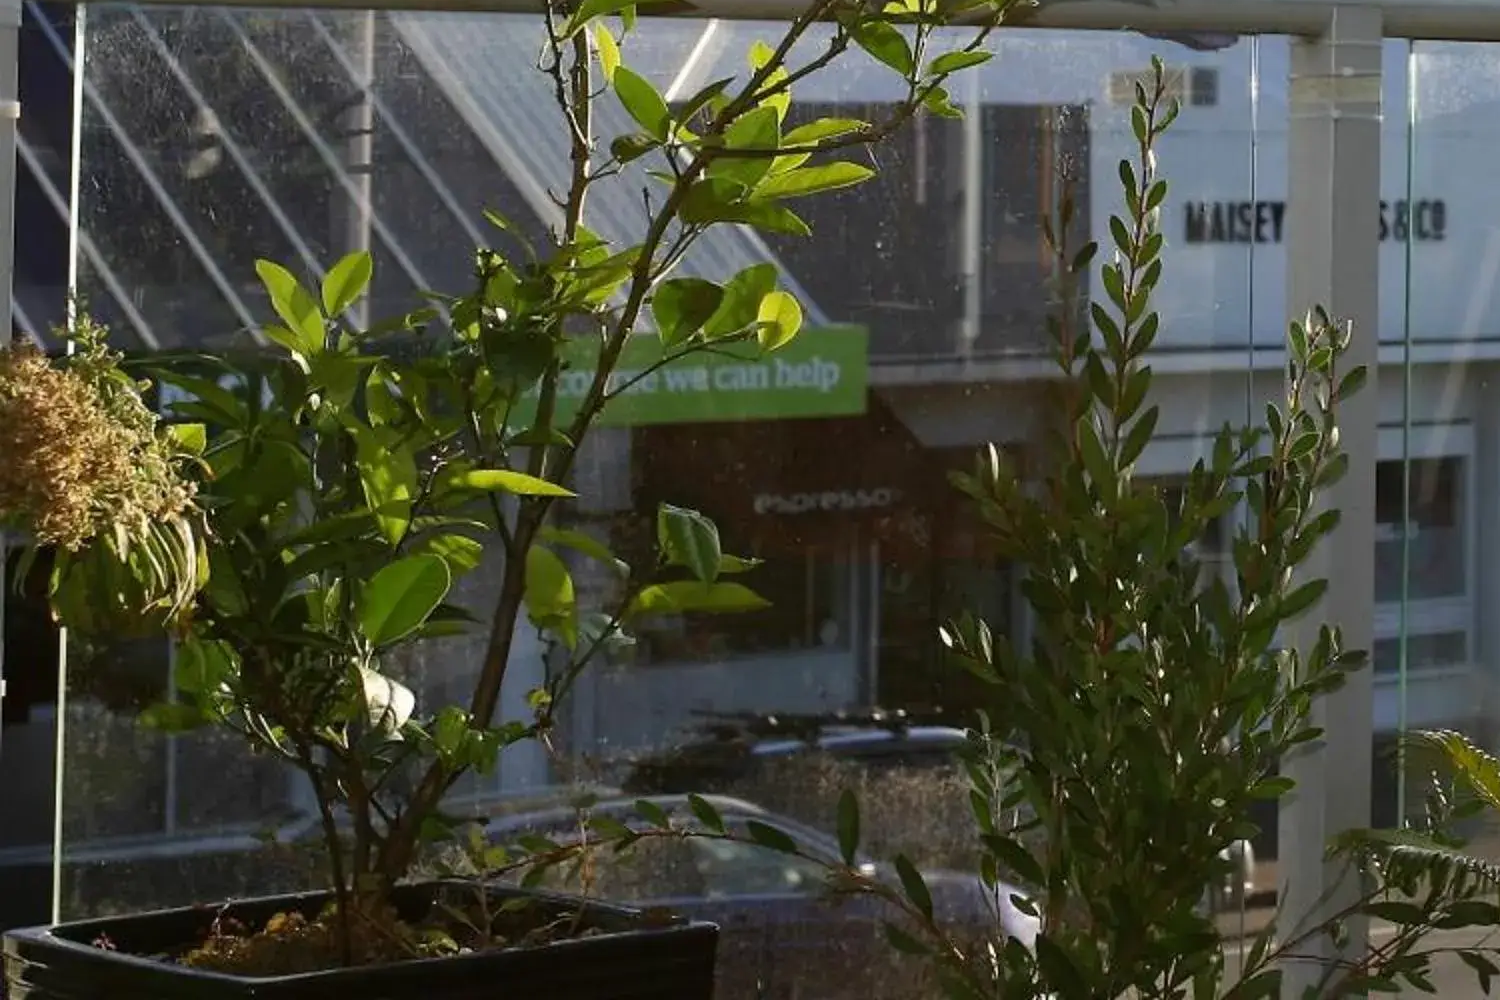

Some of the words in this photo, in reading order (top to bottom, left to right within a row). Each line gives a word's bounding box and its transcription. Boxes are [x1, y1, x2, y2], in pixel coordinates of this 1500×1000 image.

[1184, 200, 1286, 243] MAISEY
[714, 361, 770, 392] can
[775, 357, 840, 393] help
